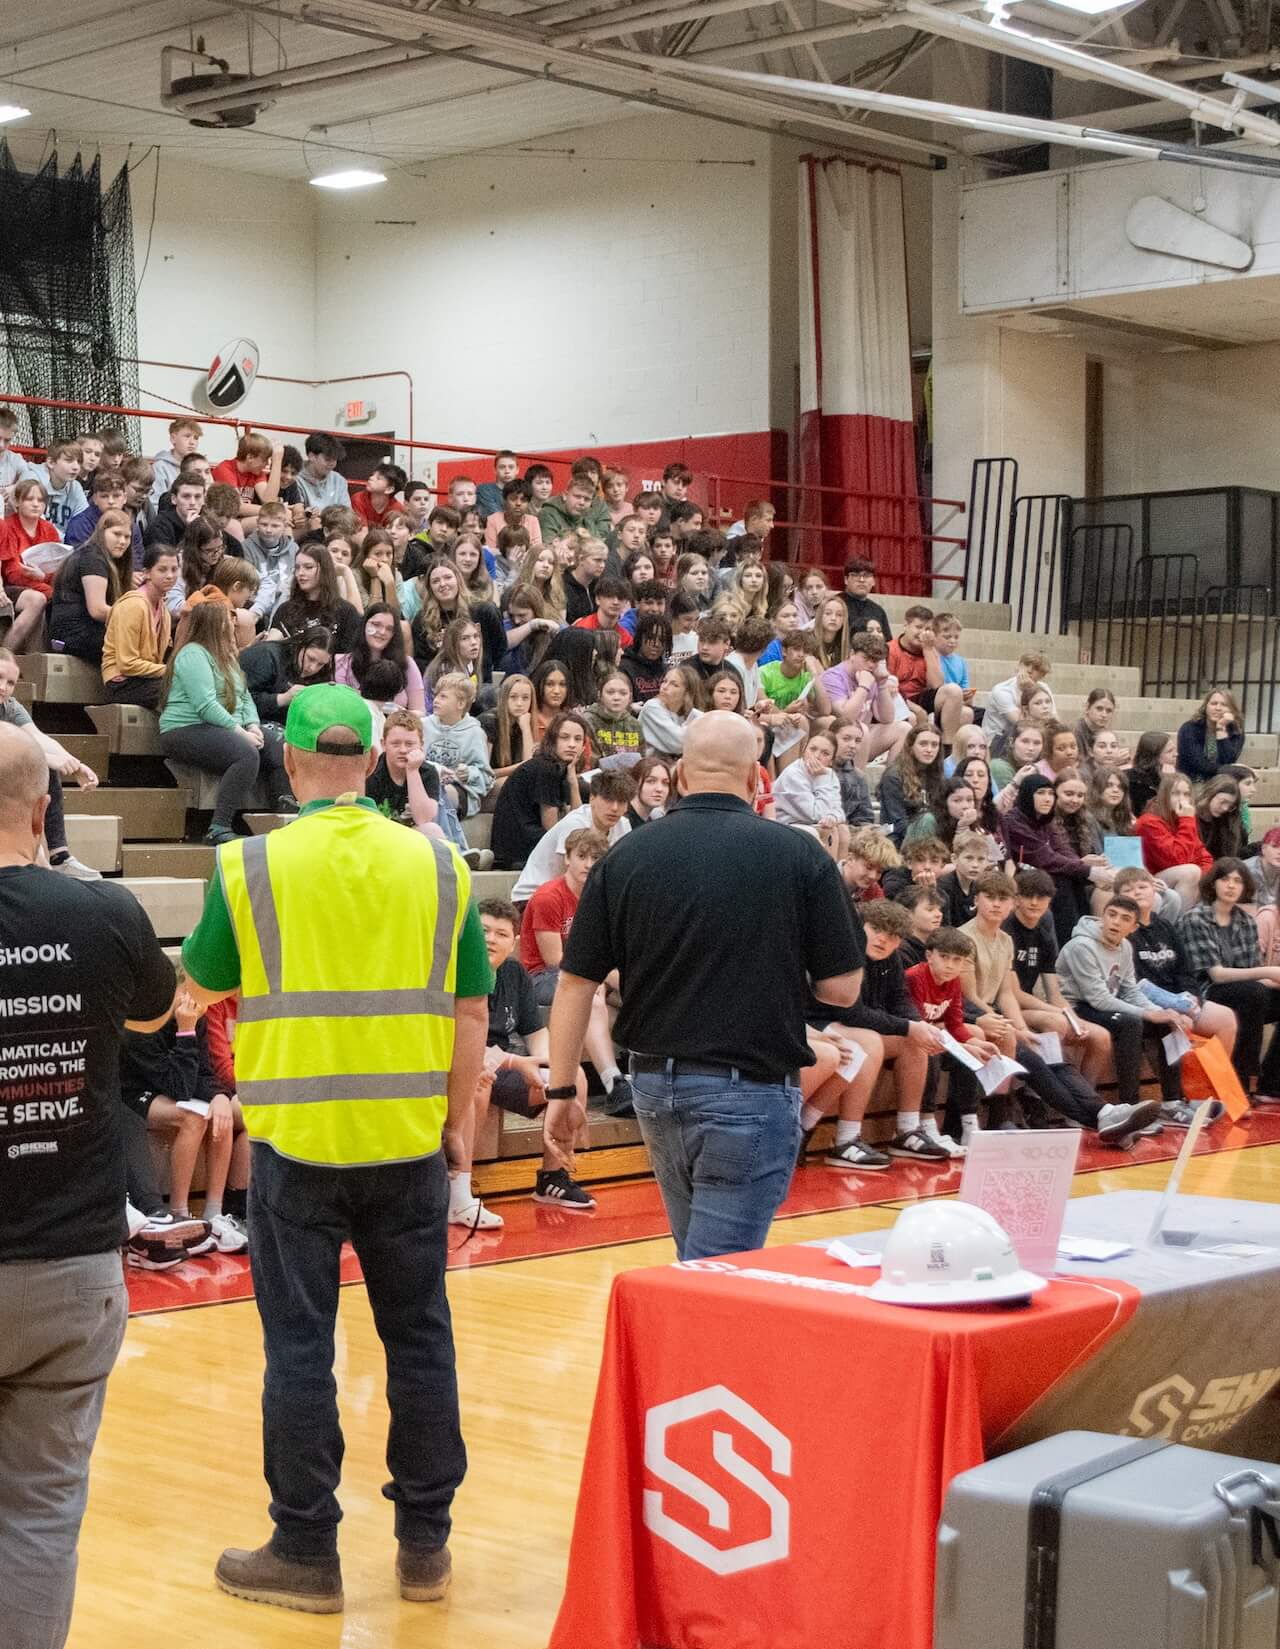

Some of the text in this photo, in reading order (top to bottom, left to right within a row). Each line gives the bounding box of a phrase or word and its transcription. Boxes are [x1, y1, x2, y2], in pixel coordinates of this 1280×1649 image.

[347, 401, 365, 417] EXIT
[59, 1059, 86, 1074] THE
[13, 1096, 84, 1124] SERVE.
[1188, 1366, 1280, 1421] SH
